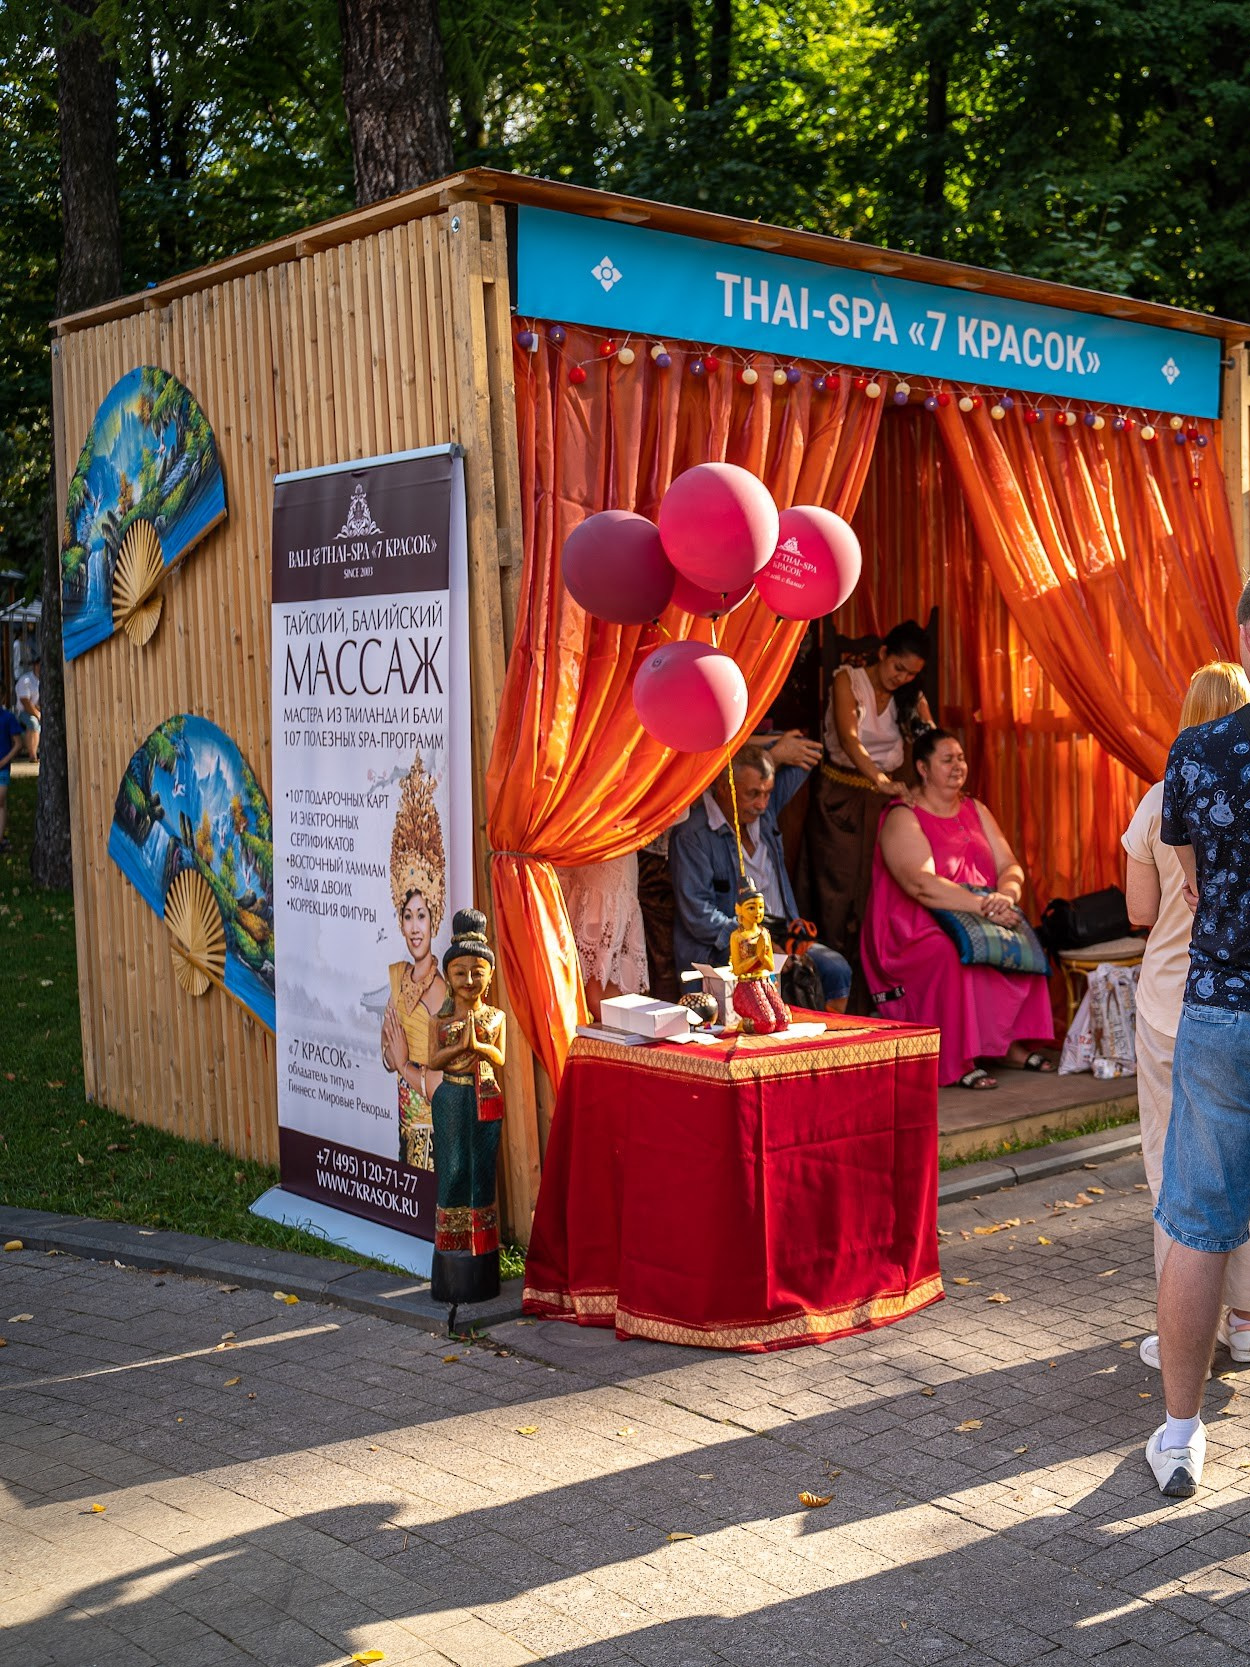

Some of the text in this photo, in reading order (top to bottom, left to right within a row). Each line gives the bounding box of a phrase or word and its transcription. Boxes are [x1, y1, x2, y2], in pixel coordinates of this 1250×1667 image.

[716, 271, 1101, 376] THAI-SPA «7 КРАСОК»
[288, 534, 438, 568] BALI & THAI-SPA «7 КРАСОК»
[782, 553, 817, 573] THAI-SPA
[343, 566, 374, 579] SINCE 2003
[772, 561, 802, 577] КРАСОК
[283, 600, 443, 636] ТАЙСКИЙ, БАЛИЙСКИЙ
[284, 636, 443, 696] МАССАЖ
[283, 707, 443, 724] МАСТЕРА ИЗ ТАИЛАНДА И БАЛИ
[284, 730, 444, 750] 107 ПОЛЕЗНЫХ SPA-ПРОГРАММ
[290, 789, 389, 809] 107 ПОДАРОЧНЫХ КАРТ
[290, 811, 359, 830] И ЭЛЕКТРОННЫХ
[290, 832, 355, 852] СЕРТИФИКАТОВ
[290, 854, 386, 879] ВОСТОЧНЫЙ ХАММАМ
[290, 875, 353, 897] SPA ДЛЯ ДВОИХ
[290, 897, 377, 923] КОРРЕКЦИЯ ФИГУРЫ
[288, 1039, 299, 1057] «7
[301, 1041, 352, 1070] КРАСОК»
[288, 1060, 355, 1091] обладатель титула
[288, 1078, 393, 1121] Гиннесс Мировые Рекорды.
[316, 1148, 418, 1194] +7 (495) 120-71-77
[316, 1168, 419, 1218] WWW.7KRASOK.RU
